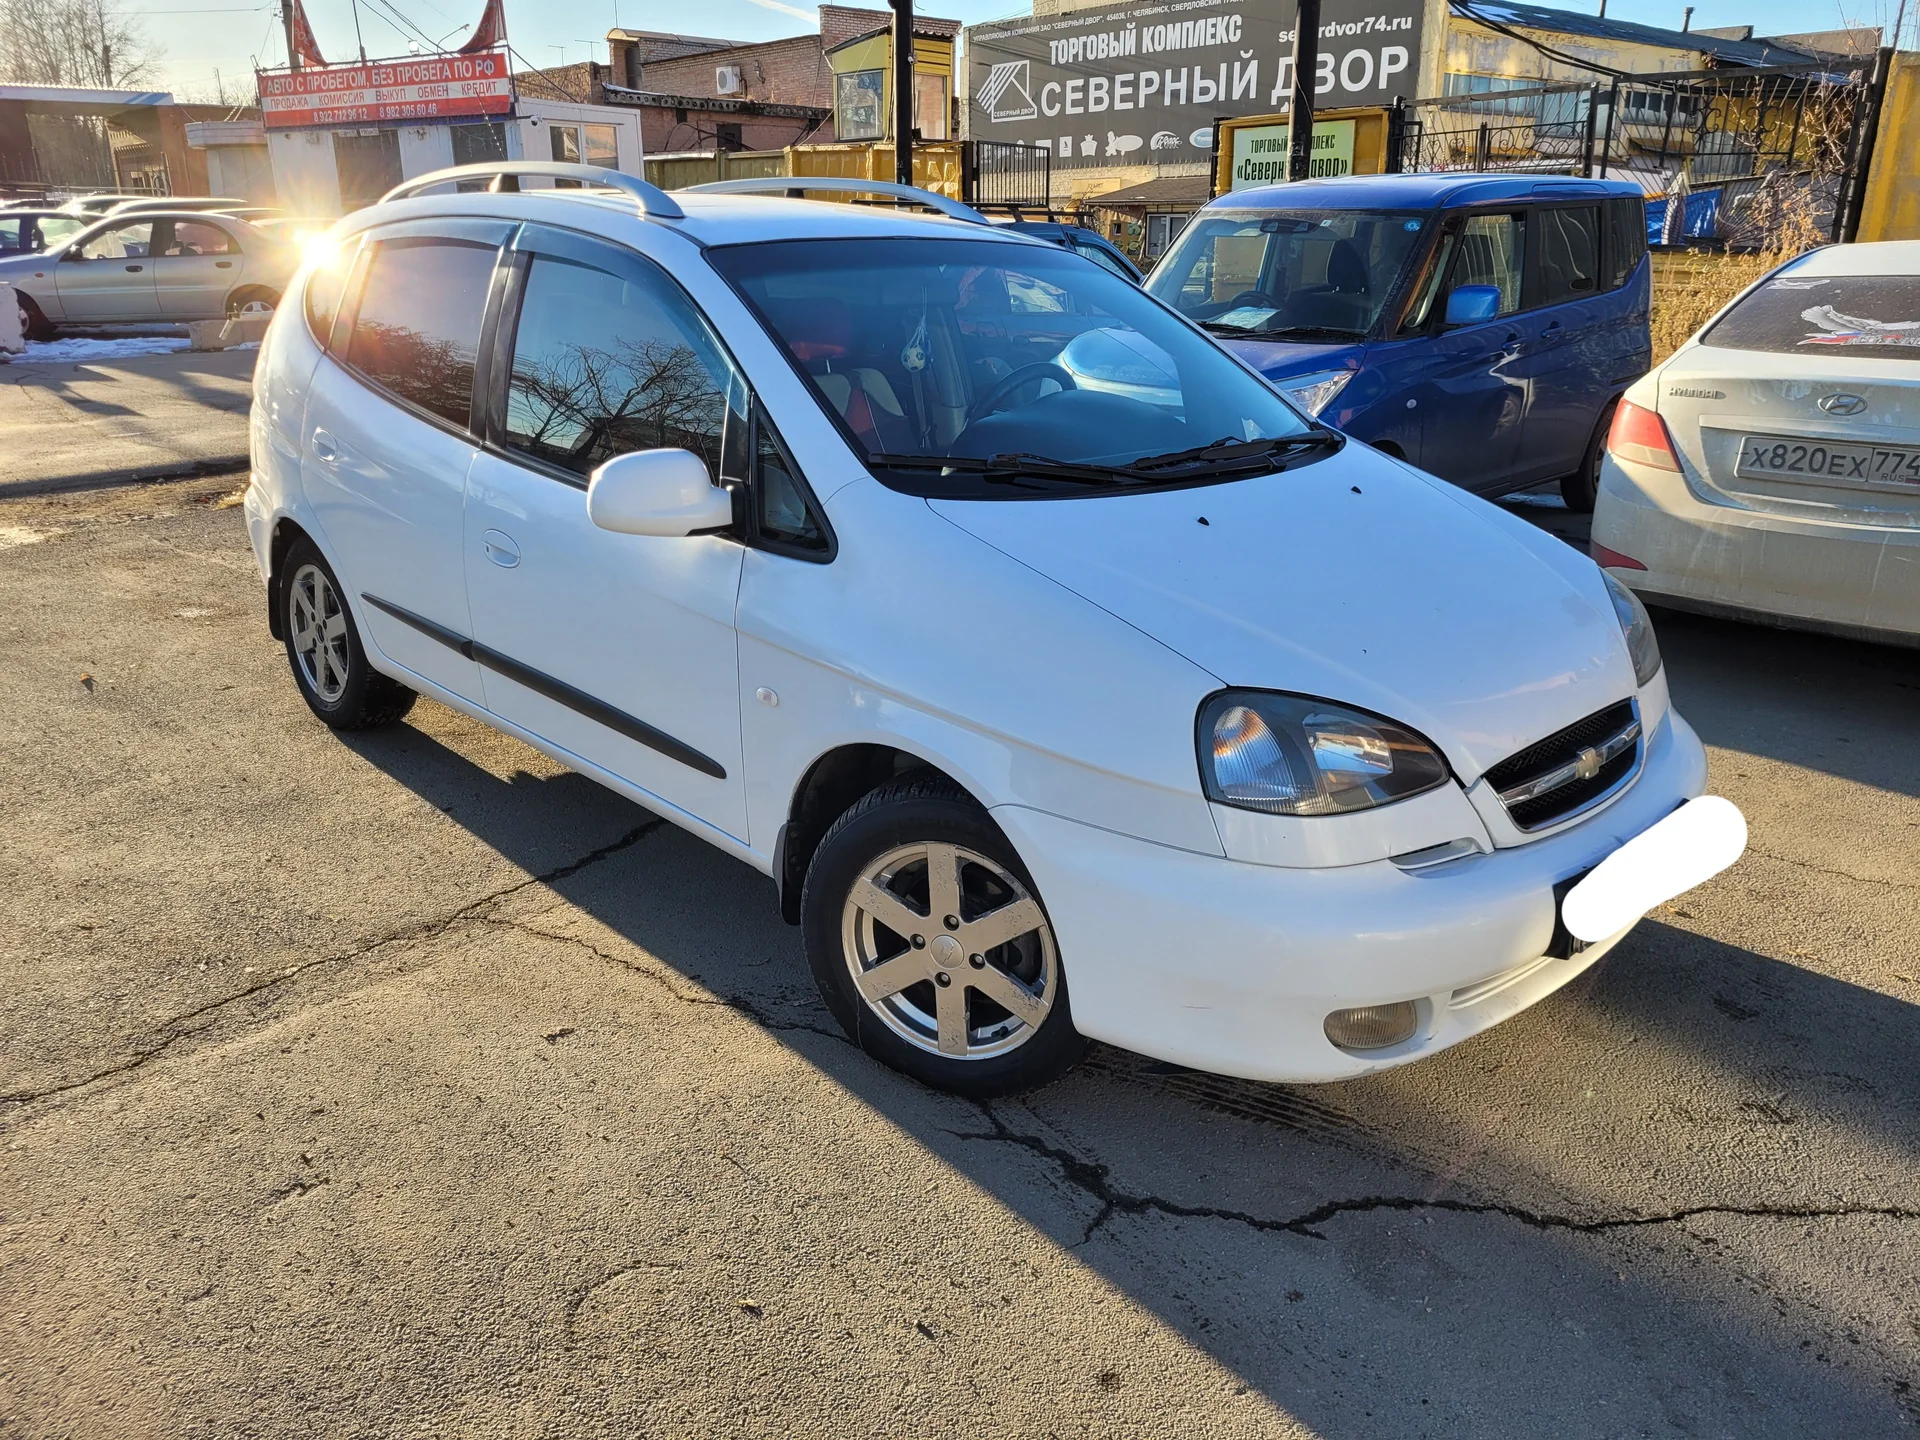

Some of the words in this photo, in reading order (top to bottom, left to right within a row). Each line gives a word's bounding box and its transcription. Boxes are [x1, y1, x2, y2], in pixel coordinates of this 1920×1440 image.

[974, 30, 1011, 42] УПРАВЛЯЮЩАЯ
[1011, 25, 1040, 37] КОМПАНИЯ
[1040, 24, 1052, 32] ЗАО
[1132, 5, 1170, 18] ЧЕЛЯБИНСК,
[1278, 15, 1413, 43] serdvor74.ru
[1050, 22, 1137, 66] ТОРГОВЫЙ
[1142, 14, 1242, 54] КОМПЛЕКС
[267, 77, 294, 95] АВТО
[296, 76, 305, 92] С
[306, 70, 370, 91] ПРОБЕГОМ,
[371, 67, 394, 85] БЕЗ
[396, 62, 452, 83] ПРОБЕГА
[454, 60, 473, 78] ПО
[475, 59, 495, 76] РФ
[1041, 49, 1259, 117] СЕВЕРНЫЙ
[1271, 46, 1409, 106] ДВОР
[270, 96, 309, 110] ПРОДАЖА
[318, 91, 365, 106] КОМИССИЯ
[375, 88, 407, 102] ВЫКУП
[417, 84, 449, 98] ОБМЕН
[461, 81, 498, 96] КРЕДИТ
[313, 111, 319, 122] 8
[319, 110, 333, 122] 922
[334, 109, 347, 120] 712
[348, 108, 357, 119] 96
[359, 107, 368, 119] 12
[379, 106, 385, 118] 8
[386, 105, 400, 118] 982
[401, 104, 415, 116] 305
[416, 103, 426, 115] 60
[427, 102, 437, 115] 46
[994, 108, 1021, 118] СЕВЕРНЫЙ
[1021, 107, 1035, 116] ДВОР
[1250, 135, 1288, 153] ТОРГОВЫЙ
[1311, 134, 1336, 150] ПЛЕКС
[1237, 159, 1285, 184] «Северн
[1669, 387, 1717, 400] HYUNDAI
[1881, 472, 1905, 482] RUS
